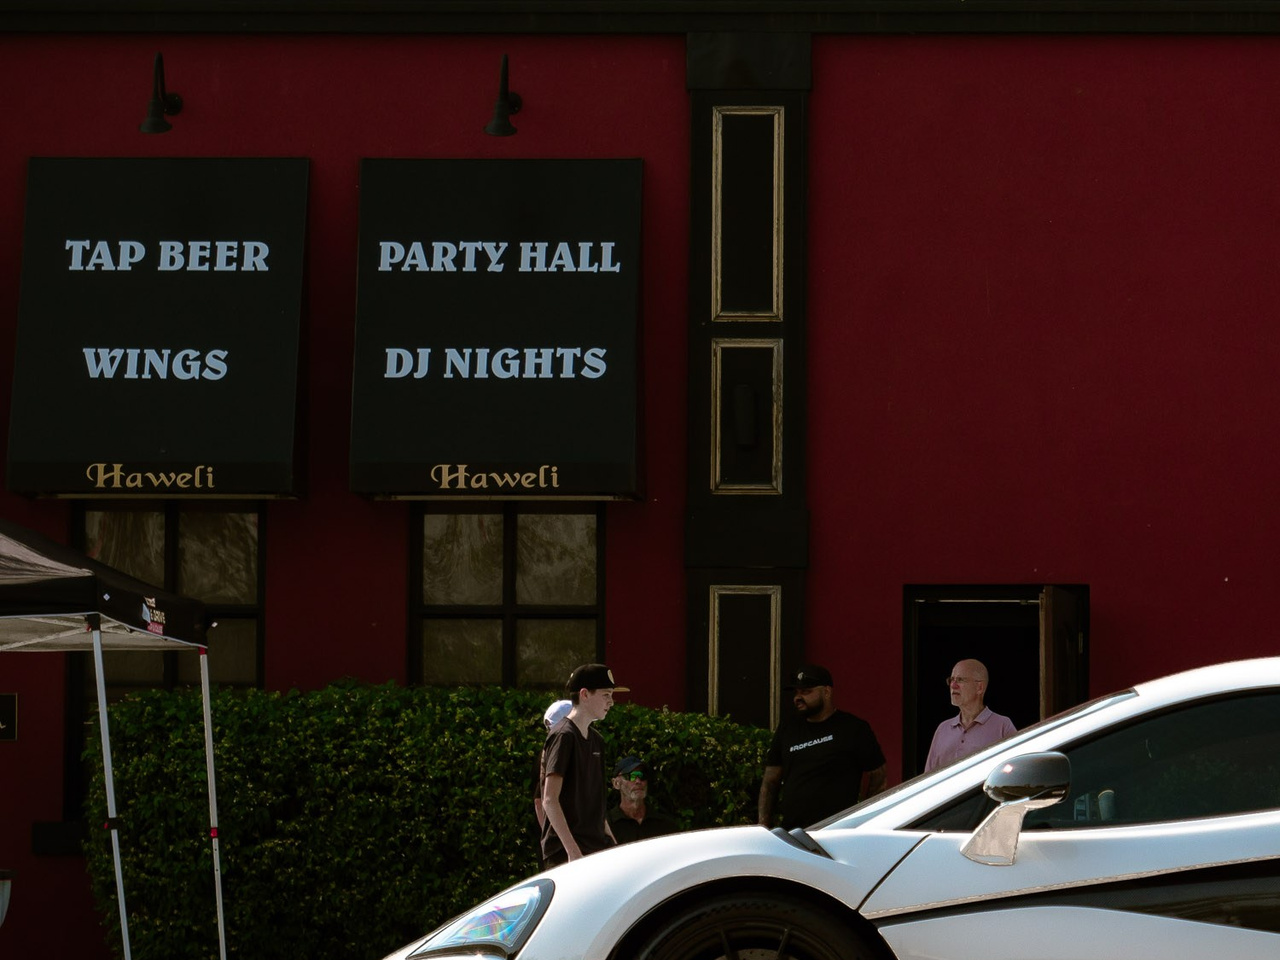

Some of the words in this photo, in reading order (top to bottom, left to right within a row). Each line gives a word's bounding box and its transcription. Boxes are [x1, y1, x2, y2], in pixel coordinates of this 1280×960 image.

[65, 239, 146, 271] TAP
[157, 240, 270, 272] BEER
[377, 240, 509, 273] PARTY
[518, 241, 621, 273] HALL
[82, 347, 229, 381] WINGS
[383, 347, 432, 379] DJ
[443, 347, 607, 379] NIGHTS
[85, 463, 216, 489] Haweli
[430, 464, 560, 489] Haweli
